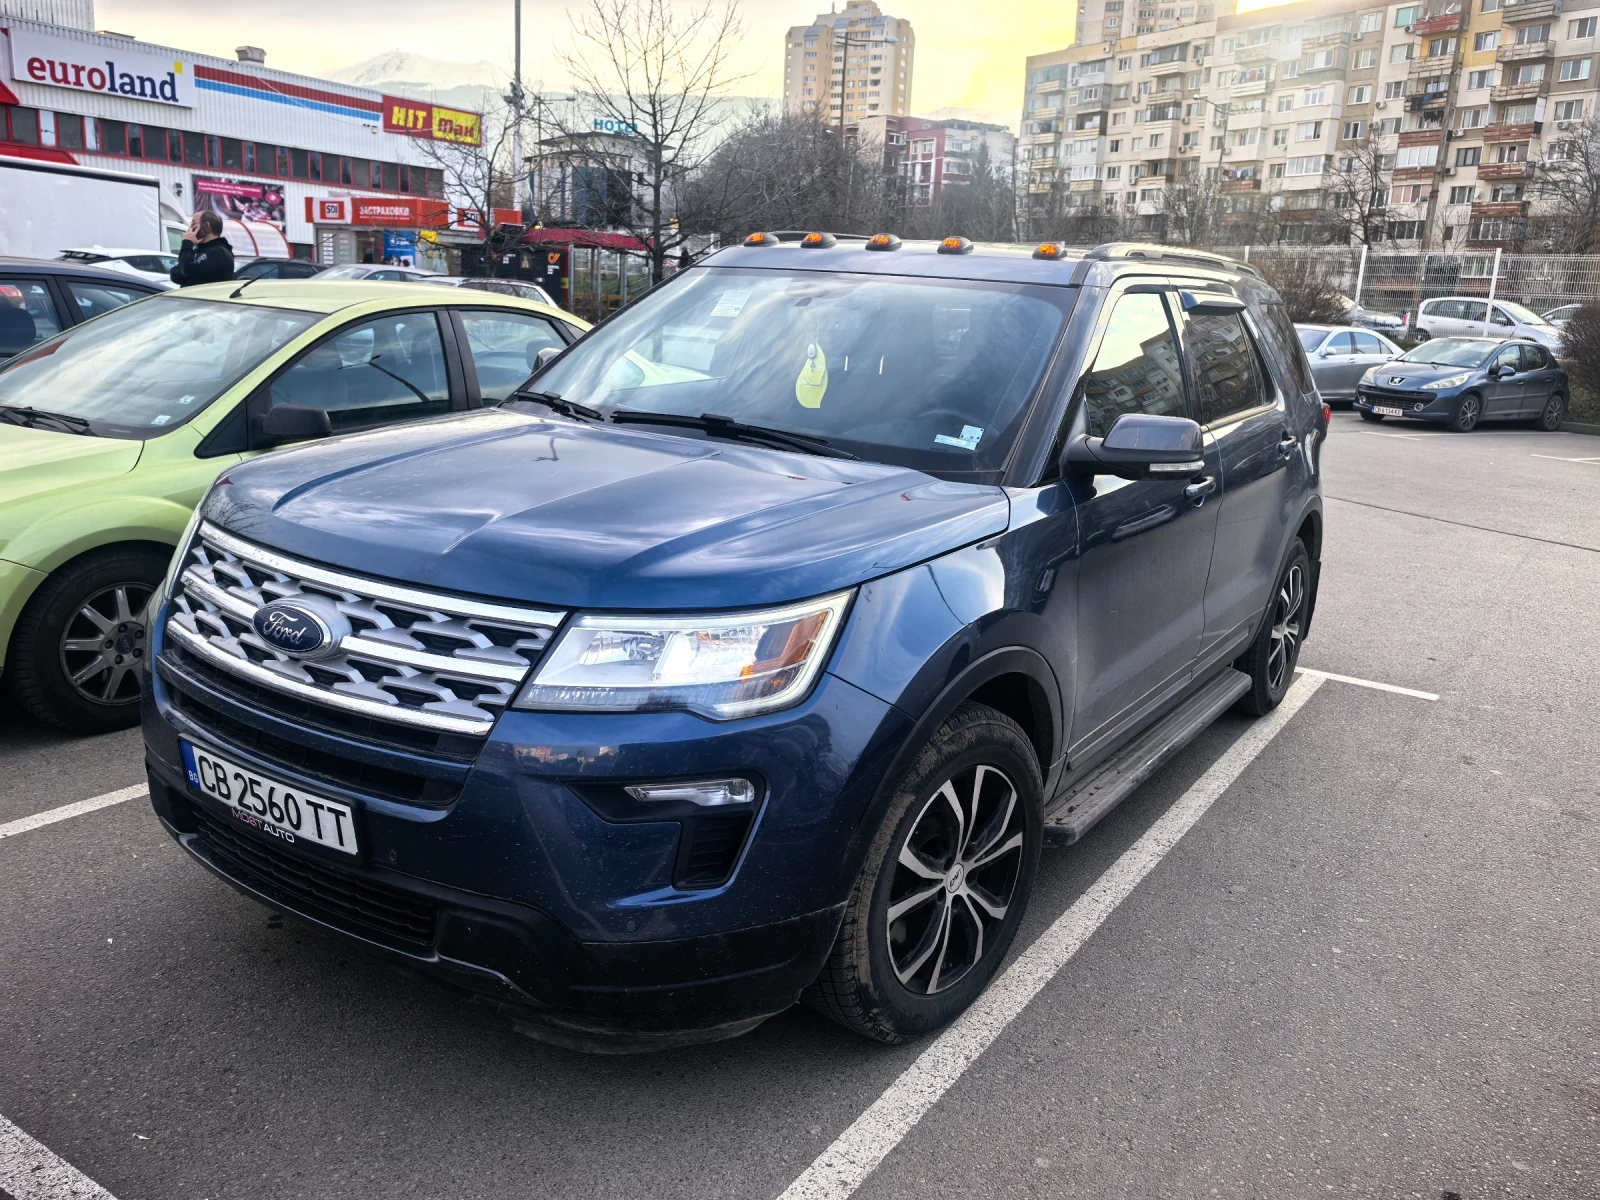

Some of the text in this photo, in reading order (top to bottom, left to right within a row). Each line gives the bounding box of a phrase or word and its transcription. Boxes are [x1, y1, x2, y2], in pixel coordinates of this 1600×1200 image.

[27, 57, 179, 103] euroland
[391, 106, 427, 129] HIT
[326, 204, 338, 214] SDI
[263, 611, 306, 645] Ford
[188, 769, 199, 784] BG
[198, 755, 347, 847] CB 2560 TT
[231, 807, 295, 844] MOST AUTO
